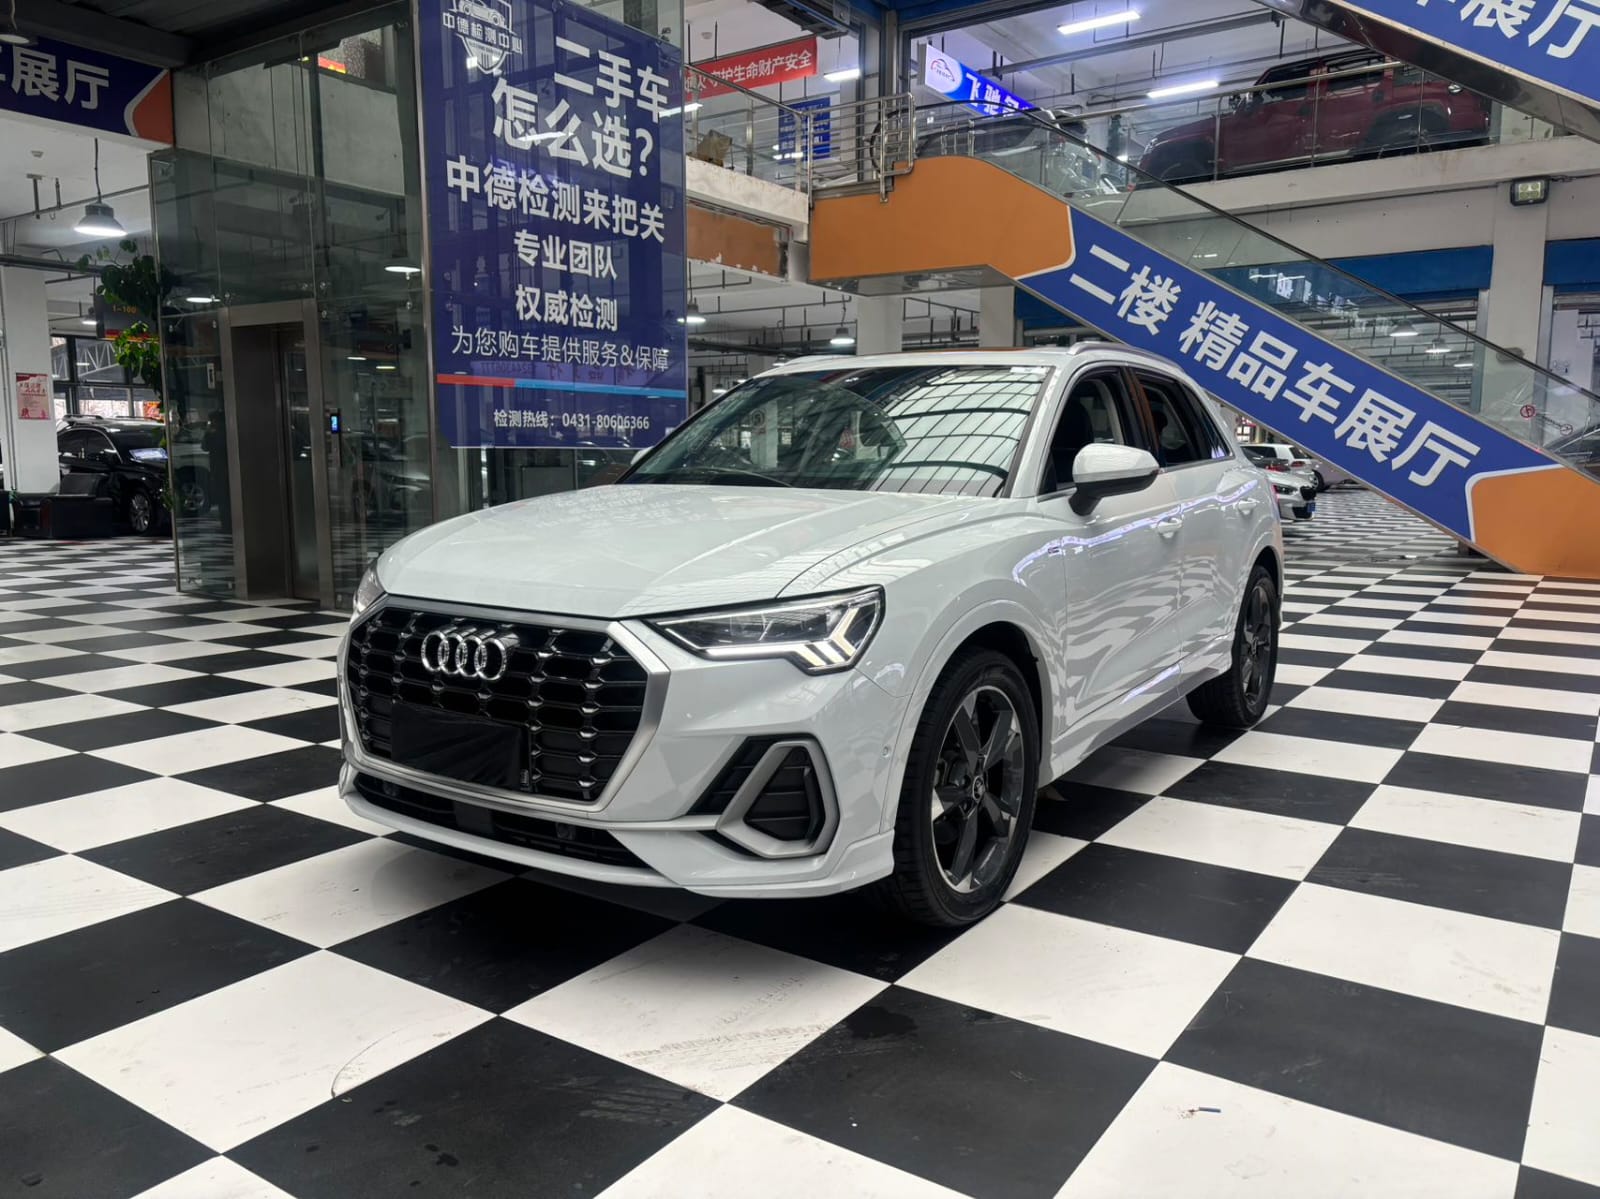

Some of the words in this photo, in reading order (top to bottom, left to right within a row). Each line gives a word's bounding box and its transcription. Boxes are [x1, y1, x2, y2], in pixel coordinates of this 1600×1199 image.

[442, 12, 523, 55] 中德检测中心
[1417, 0, 1600, 58] 展厅
[0, 43, 109, 110] 展厅
[554, 36, 669, 124] 二手车
[491, 77, 654, 178] 怎么选？
[446, 155, 664, 243] 中德检测来把关
[514, 229, 618, 280] 专业团队
[515, 284, 618, 332] 权威检测
[451, 325, 669, 372] 为您购车提供服务&保障
[1069, 244, 1180, 336] 二楼
[1179, 301, 1481, 487] 精品车展厅
